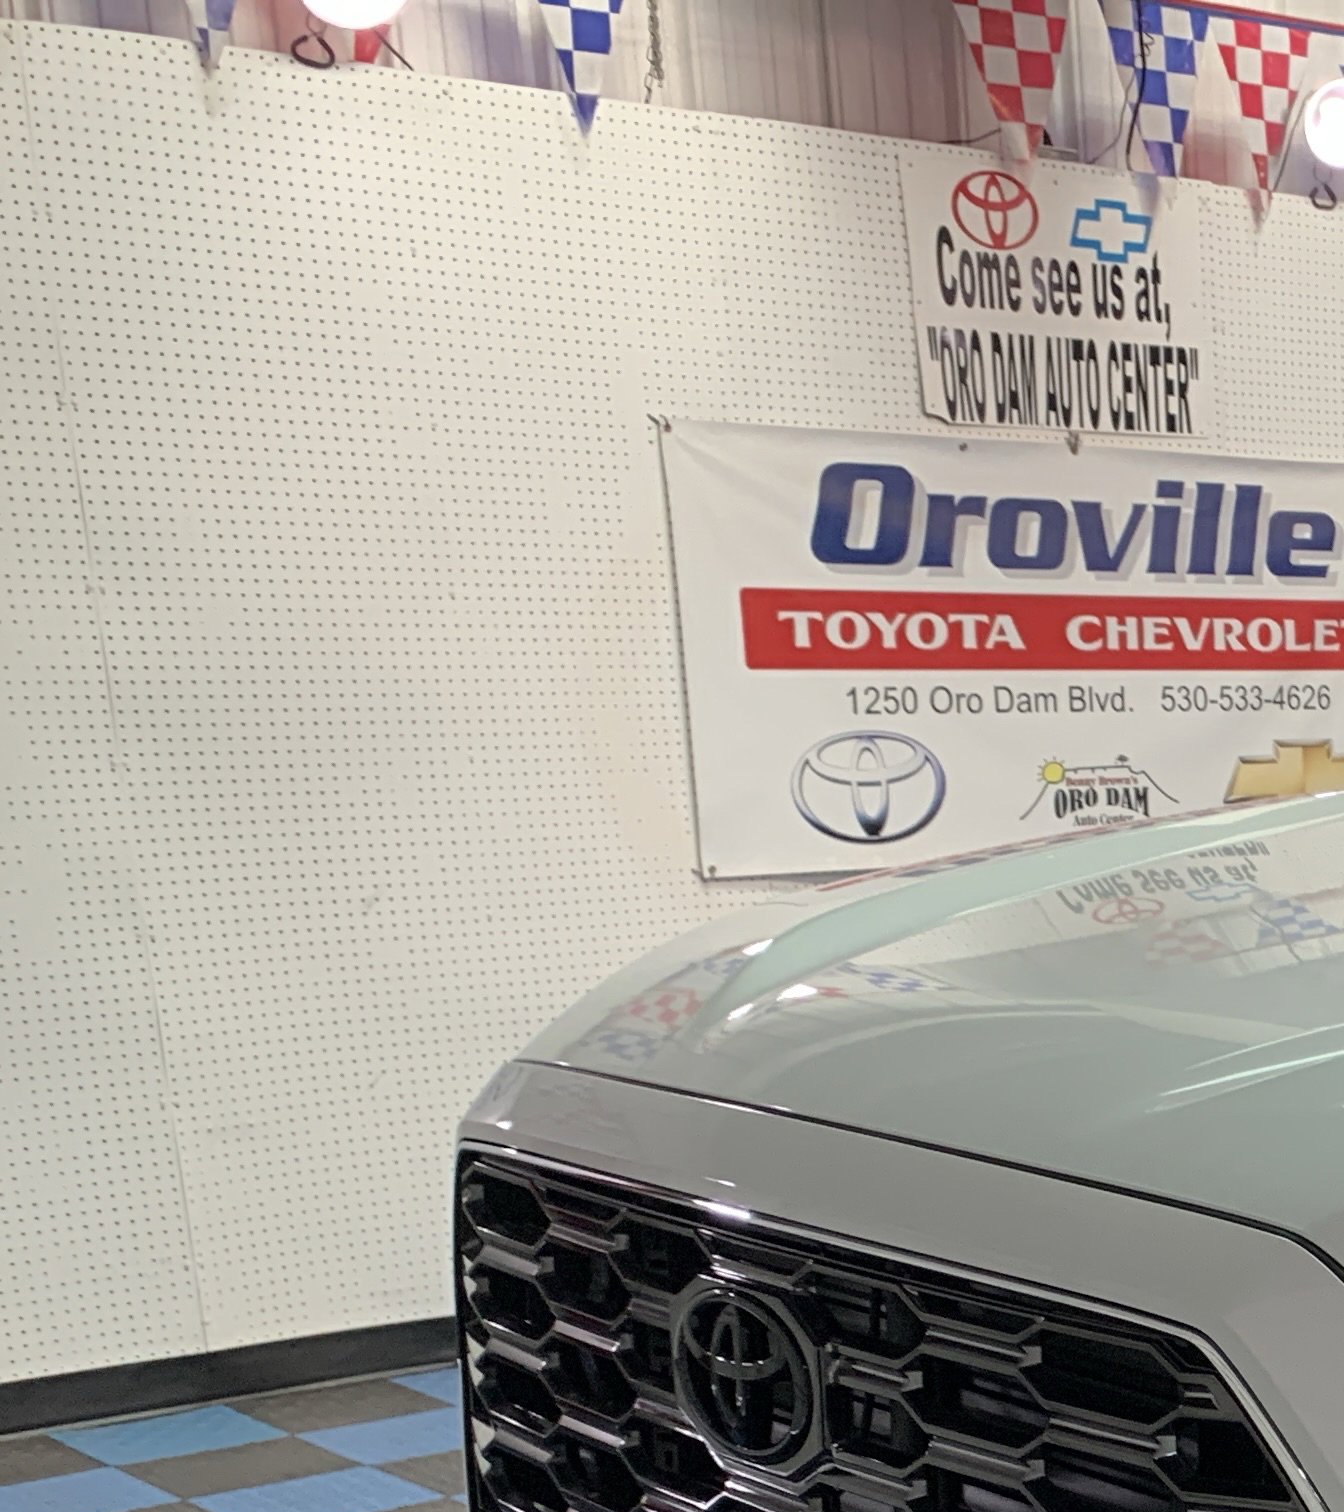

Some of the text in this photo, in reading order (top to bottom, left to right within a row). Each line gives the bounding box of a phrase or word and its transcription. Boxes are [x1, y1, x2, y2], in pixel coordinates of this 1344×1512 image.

[936, 225, 1170, 341] Come see us at,
[926, 326, 1199, 434] "ORO DAM AUTO CENTER"
[811, 461, 1340, 582] Oroville
[778, 611, 1025, 650] TOYOTA
[846, 685, 1332, 716] 1250 Oro Dam Blvd. 530-533-4626
[1054, 786, 1150, 819] ORO DAM
[1073, 814, 1098, 826] Auto
